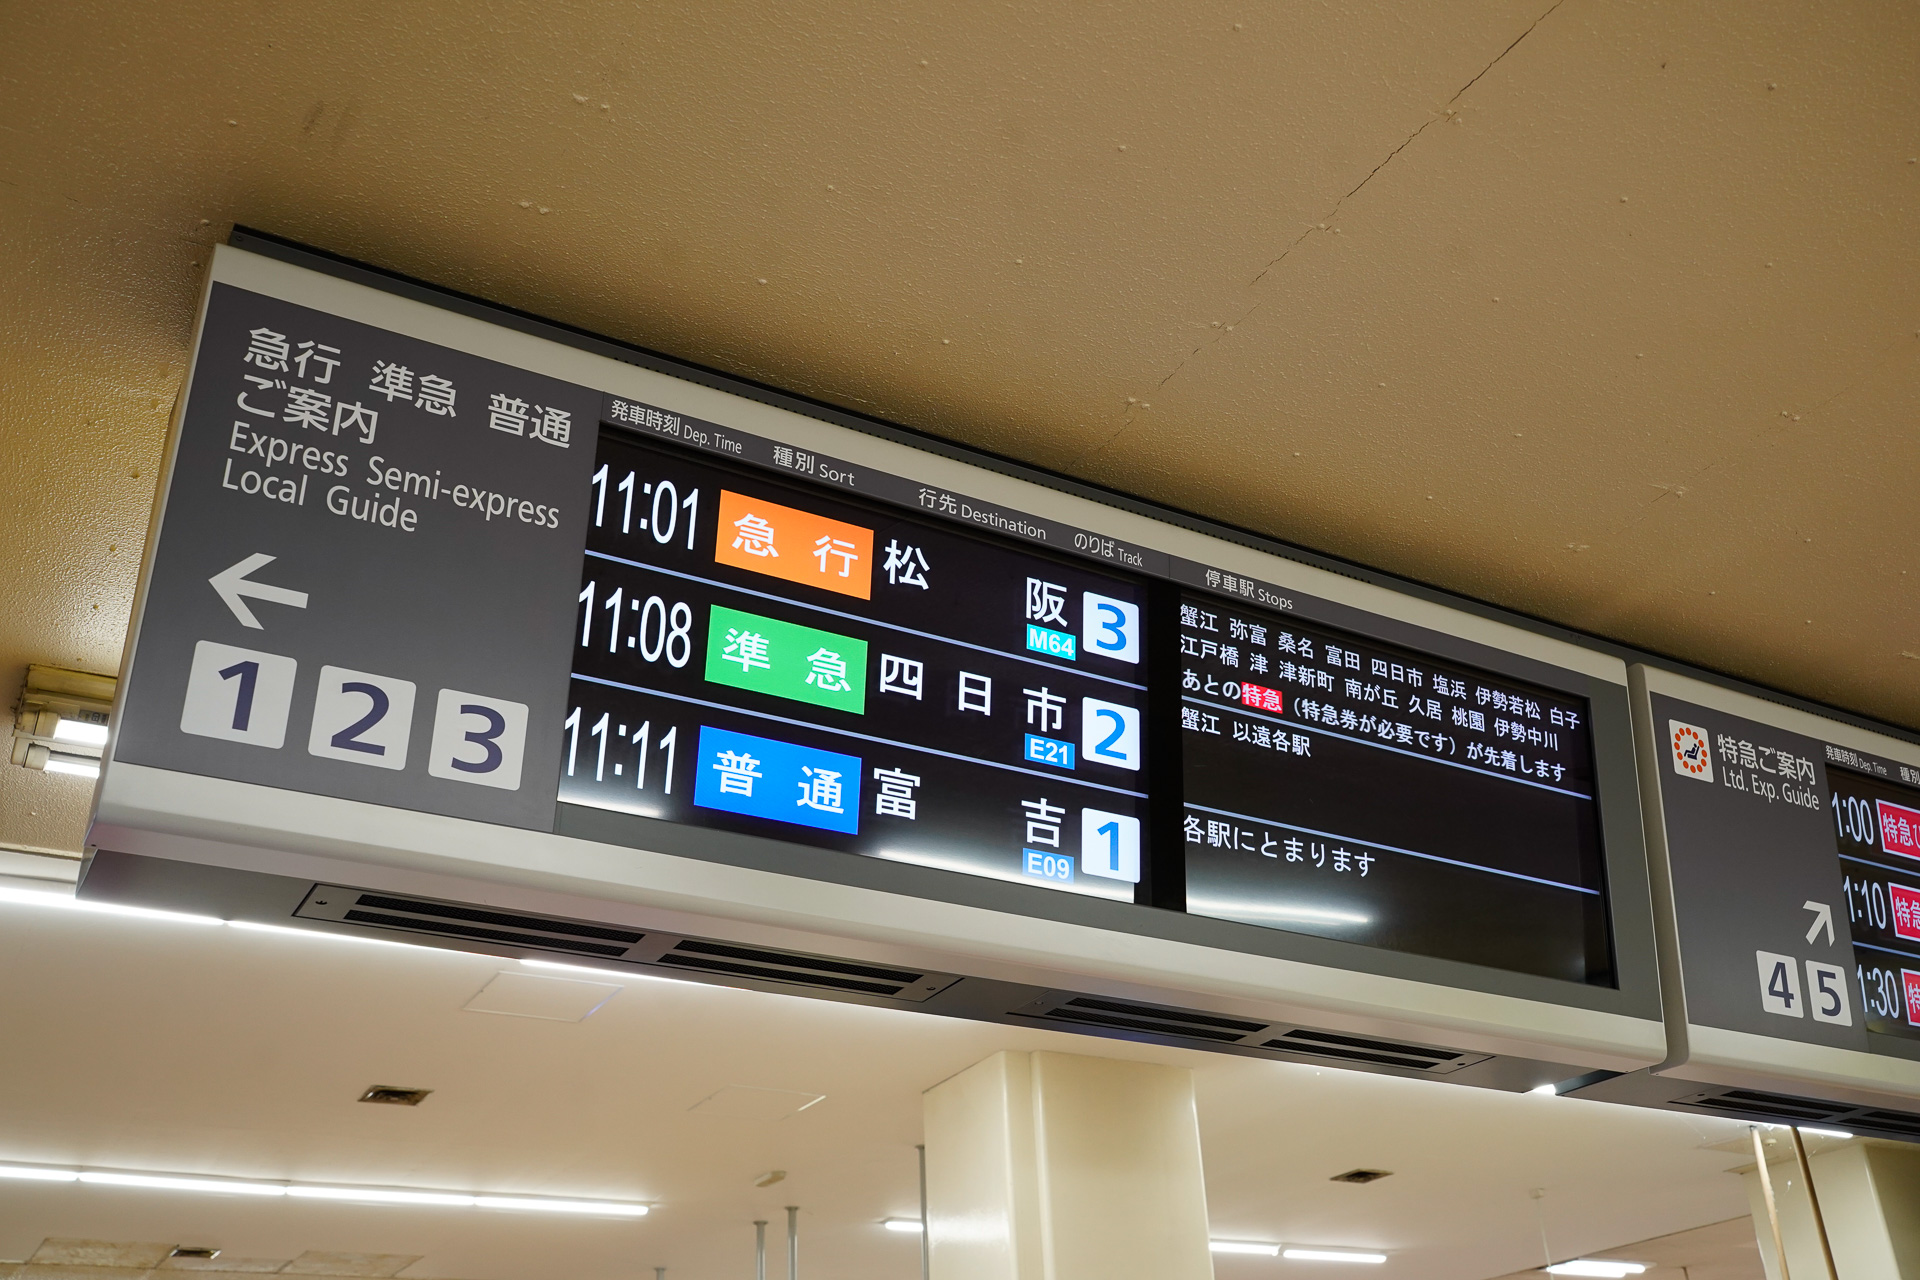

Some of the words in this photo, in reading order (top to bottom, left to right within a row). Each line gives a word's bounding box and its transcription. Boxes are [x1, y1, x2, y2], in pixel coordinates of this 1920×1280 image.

[236, 372, 379, 445] ご案内
[243, 326, 341, 384] 急行
[369, 358, 457, 418] 準急
[488, 393, 572, 449] 普通
[610, 398, 680, 437] 発車時刻
[684, 424, 711, 448] Dep.
[714, 431, 742, 455] Time
[229, 421, 348, 478] Express
[367, 455, 561, 529] Semi-express
[773, 445, 815, 474] 種別
[819, 462, 855, 487] Sort
[222, 457, 308, 507] Local
[327, 485, 418, 533] Guide
[918, 488, 957, 514] 行先
[961, 503, 1046, 540] Destination
[591, 462, 700, 551] 11:01
[731, 513, 859, 580] 急行
[1095, 602, 1128, 650] 3
[1074, 531, 1115, 557] のりば
[1117, 547, 1143, 567] Track
[1205, 569, 1255, 599] 停車駅
[1258, 589, 1293, 610] Stops
[578, 580, 693, 668] 11:08
[721, 627, 851, 693] 準急
[1094, 709, 1128, 760] 2
[1029, 628, 1074, 657] M64
[1180, 603, 1219, 633] 蟹江
[1229, 617, 1267, 646] 弥富
[1278, 632, 1314, 659] 桑名
[1325, 645, 1360, 671] 富田
[1371, 658, 1423, 688] 四日市
[1432, 674, 1467, 701] 塩浜
[1475, 685, 1541, 721] 伊勢若松
[1550, 707, 1580, 731] 白子
[218, 660, 260, 732] 1
[330, 682, 391, 756] 2
[451, 704, 507, 773] 3
[1180, 635, 1240, 669] 江戸橋
[1249, 652, 1269, 674] 津
[1279, 660, 1334, 692] 津新町
[1345, 678, 1399, 710] 南が丘
[1409, 695, 1443, 720] 久居
[1451, 706, 1486, 732] 桃園
[1494, 718, 1559, 751] 伊勢中川
[1028, 738, 1070, 766] E21
[1181, 706, 1221, 736] 蟹江
[1232, 721, 1312, 757] 以遠各駅
[1717, 734, 1816, 786] 特急ご案内
[1825, 745, 1858, 767] 発車時刻
[1859, 757, 1873, 772] Dep.
[1874, 762, 1887, 776] Time
[1900, 766, 1920, 785] 種別
[563, 706, 678, 794] 11:11
[712, 749, 845, 815] 普通
[1096, 821, 1121, 871] 1
[1723, 766, 1749, 792] Ltd.
[1752, 774, 1780, 803] Exp.
[1783, 782, 1820, 811] Guide
[1026, 852, 1070, 880] E09
[1183, 815, 1375, 877] 各駅にとまります
[1768, 961, 1794, 1008] 4
[1819, 970, 1841, 1017] 5
